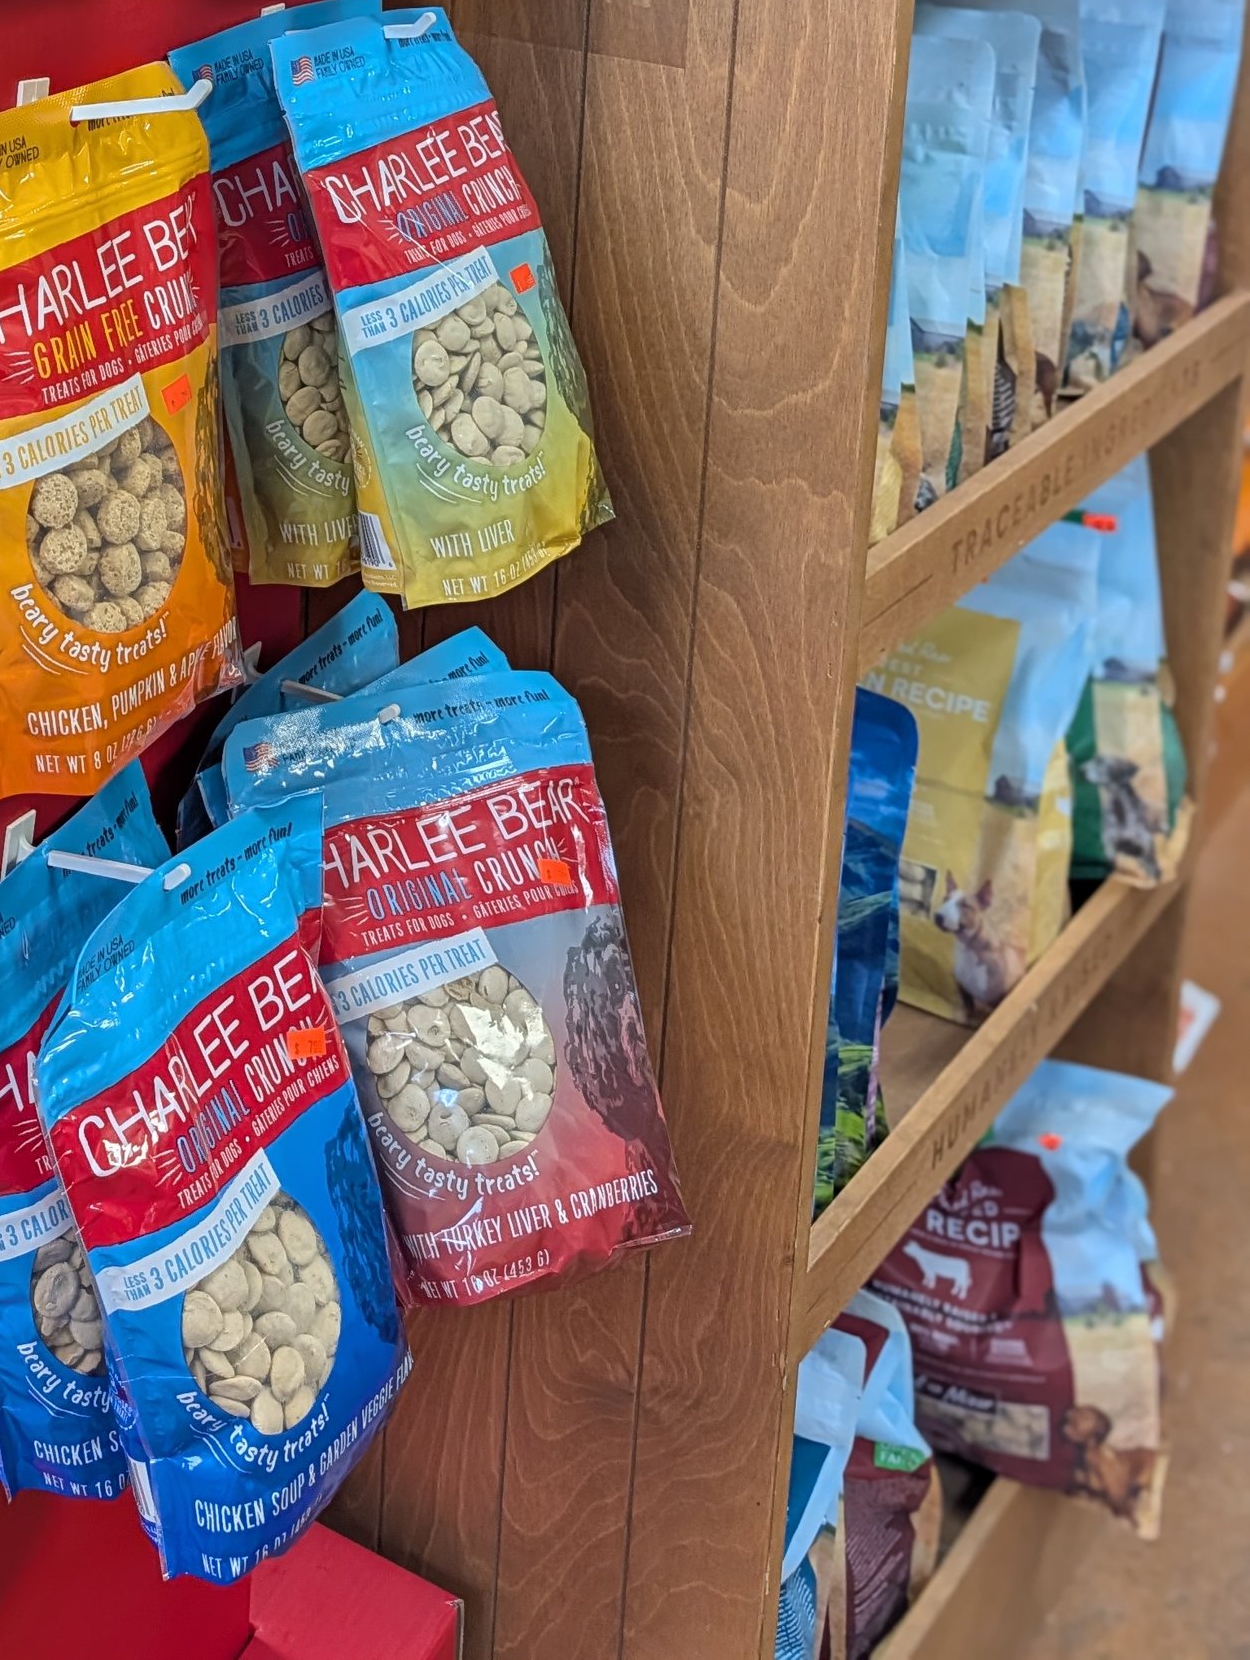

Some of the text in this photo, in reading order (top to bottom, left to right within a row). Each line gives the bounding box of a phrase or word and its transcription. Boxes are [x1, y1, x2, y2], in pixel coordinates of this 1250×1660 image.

[5, 146, 39, 171] OWNED
[8, 136, 27, 154] USA
[360, 311, 382, 325] LESS
[385, 307, 396, 328] 3
[399, 275, 453, 322] CALORIES
[468, 256, 492, 286] TREAT
[33, 299, 143, 379] GRAIN FREE
[362, 323, 386, 338] THAN
[41, 379, 79, 404] TREATS
[81, 370, 98, 389] FOR
[99, 357, 124, 380] DOGS
[135, 336, 172, 364] GÂTERIES
[4, 385, 145, 476] 3 CALORIES PER TREAT
[406, 424, 499, 501] beary tasty
[430, 520, 515, 558] WITH LIVER
[950, 453, 1074, 572] TRACEABLE
[11, 583, 111, 673] beary tasty
[27, 662, 178, 737] CHICKEN, PUMPKIN &
[892, 675, 991, 723] RECIPE
[35, 753, 60, 774] NET
[67, 753, 86, 774] WT
[93, 751, 102, 770] 8
[180, 822, 293, 905] more treats more fun!
[362, 889, 552, 947] TREATS FOR DOGS GÂTERIES POUR
[338, 939, 487, 1012] 3 CALORIES PER TREAT
[252, 1058, 340, 1138] GÂTERIES POUR CHIENS
[368, 1112, 470, 1200] beary tasty
[150, 1162, 270, 1289] 3 CALORIES PER TREAT
[440, 1216, 502, 1252] TURKEY
[507, 1201, 550, 1233] LIVER
[555, 1200, 569, 1224] &
[571, 1171, 659, 1218] CRANBERRIES
[123, 1275, 147, 1290] LESS
[125, 1284, 151, 1300] THAN
[34, 1442, 102, 1466] CHICKEN
[175, 1391, 280, 1472] beary tasty
[196, 1380, 394, 1535] CHICKEN SOUP & GARDEN VEGGIE
[44, 1472, 113, 1496] NET WT 16
[203, 1552, 247, 1579] NET WT
